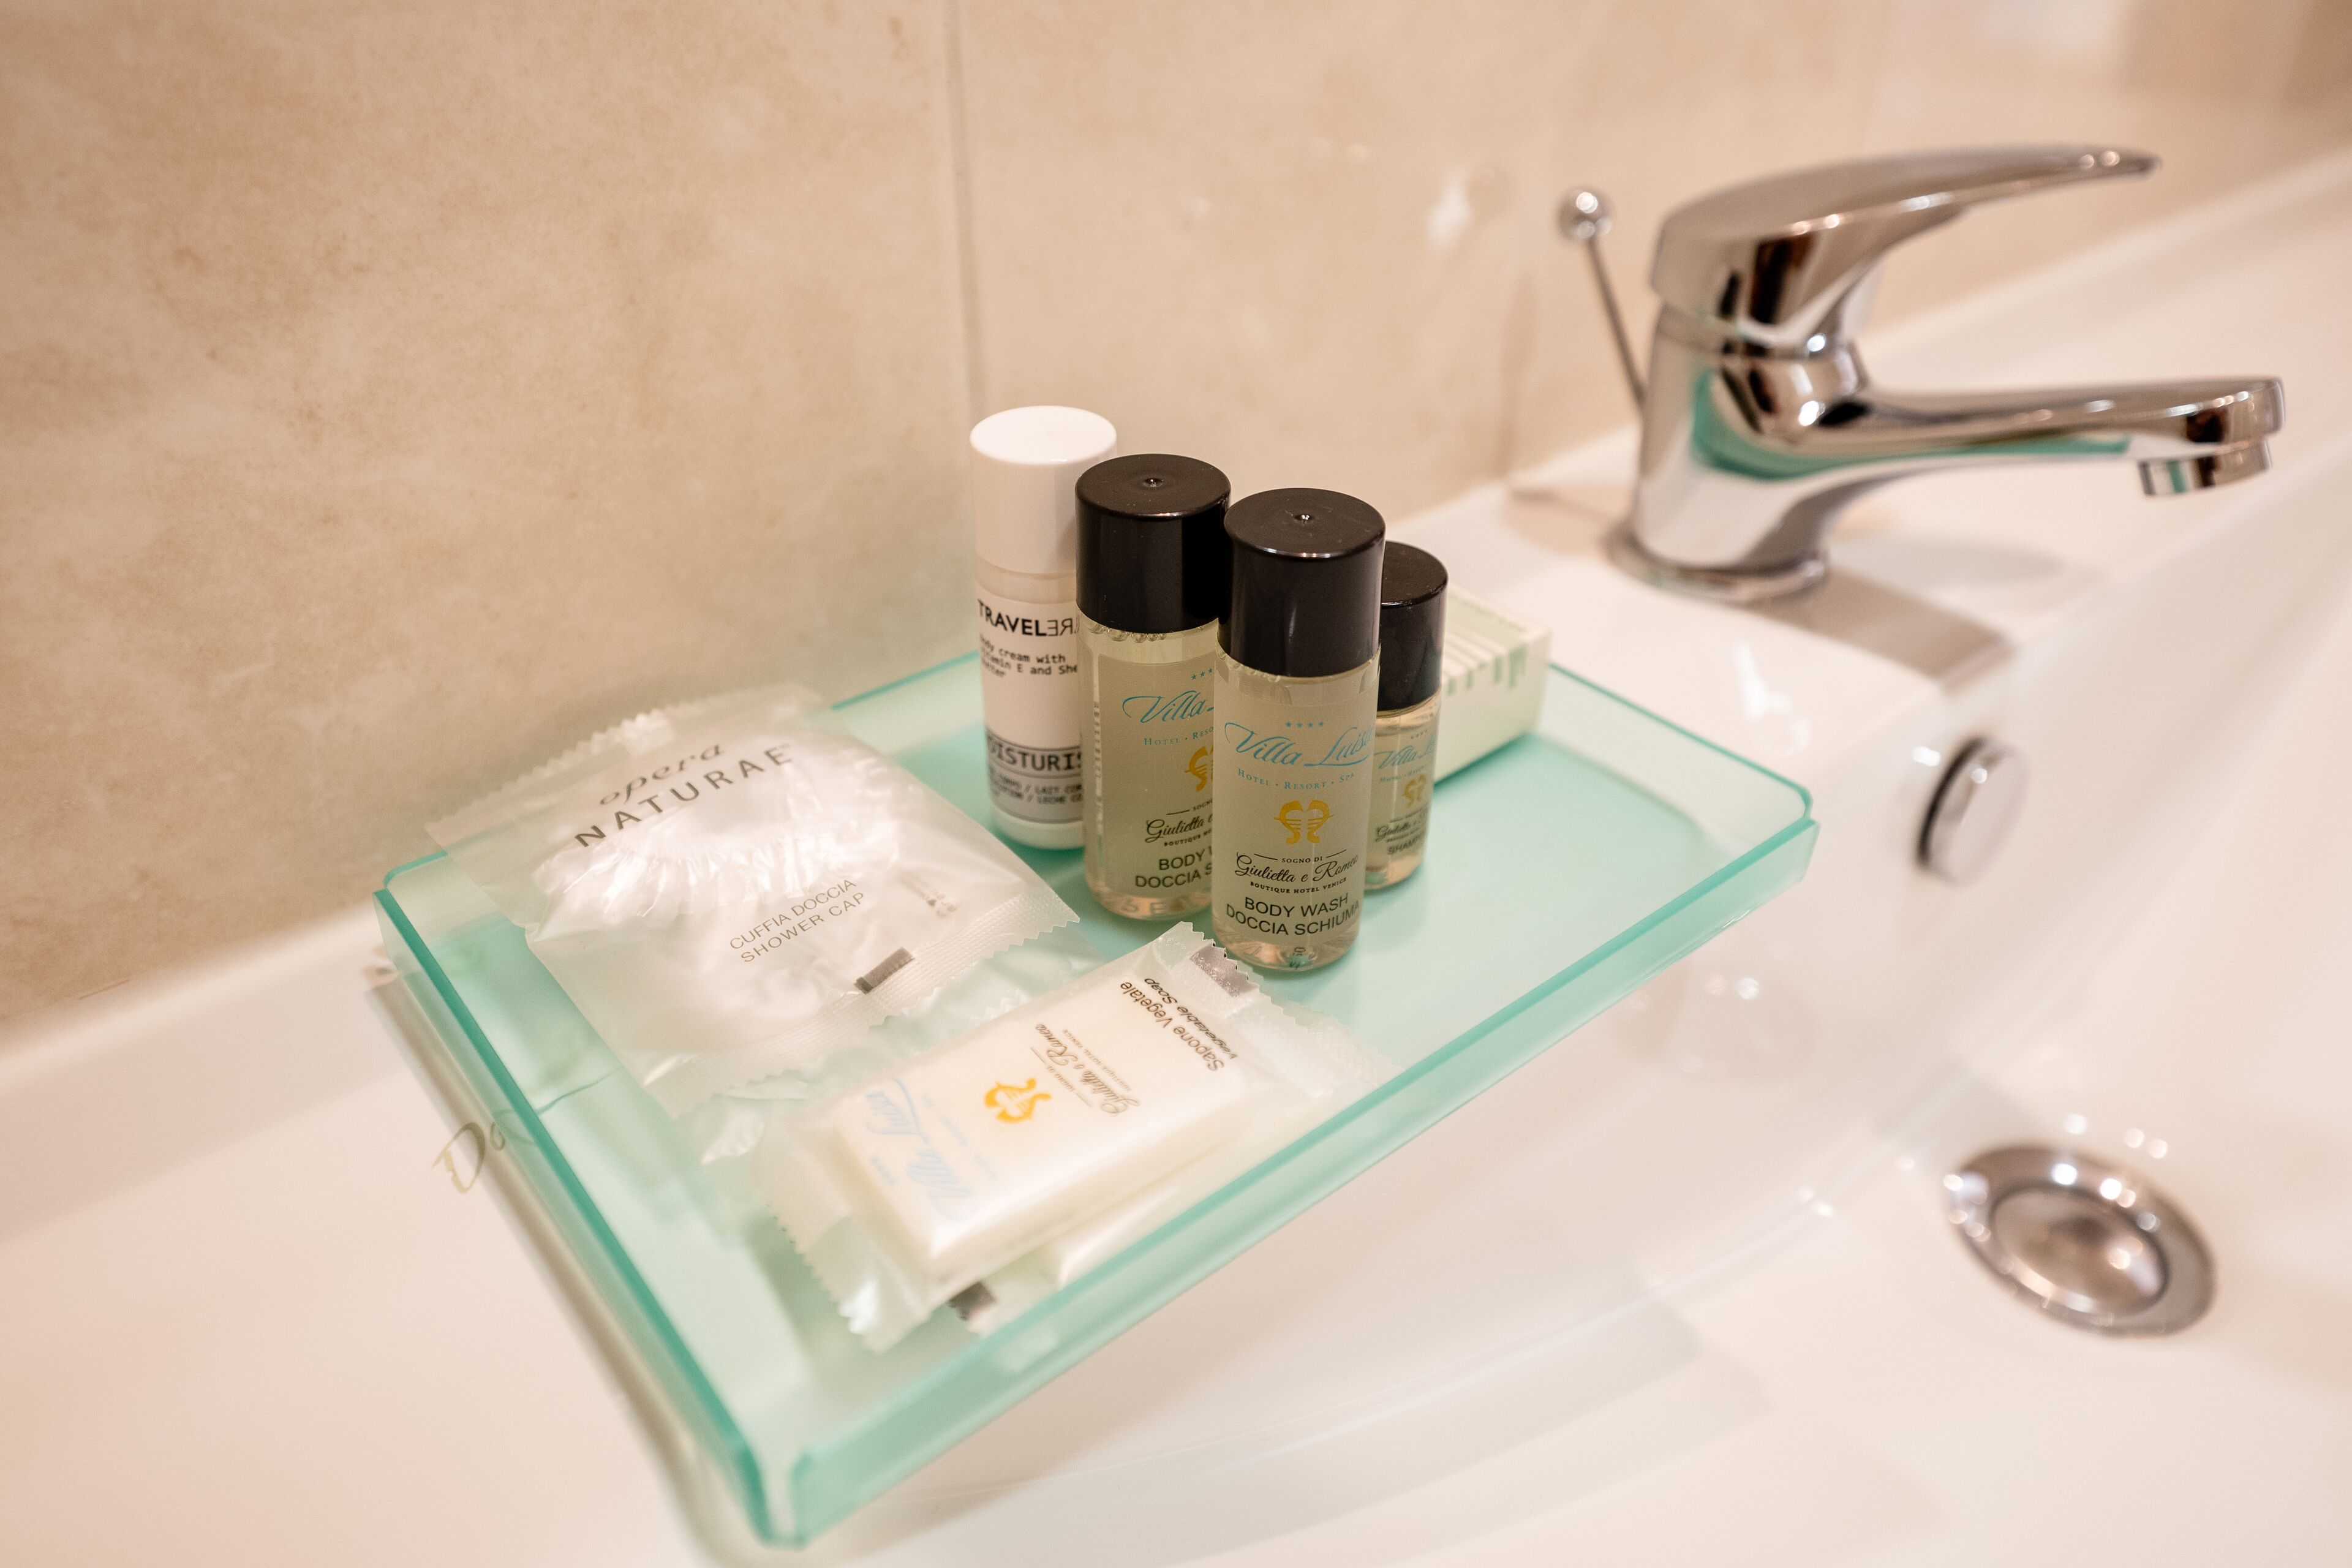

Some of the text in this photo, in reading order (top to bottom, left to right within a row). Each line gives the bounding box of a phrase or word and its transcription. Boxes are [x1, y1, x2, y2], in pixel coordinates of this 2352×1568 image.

[998, 648, 1030, 663] cream
[1035, 654, 1066, 664] with
[1017, 663, 1023, 673] E
[1030, 665, 1052, 675] and
[1122, 690, 1205, 723] Villa
[1225, 722, 1303, 766] Villa
[600, 743, 723, 805] opera
[575, 744, 792, 848] NATURAE
[1145, 815, 1205, 843] Giulietta
[1163, 834, 1201, 846] BOUTIQUE
[1159, 848, 1205, 870] BODY
[1234, 851, 1296, 883] Giulietta
[1301, 873, 1308, 882] e
[1313, 855, 1359, 881] Romeo
[1135, 869, 1202, 889] DOCCIA
[1250, 881, 1291, 894] BOUTIQUE
[1322, 876, 1347, 890] VENICE
[729, 913, 791, 949] CUFFIA
[791, 879, 857, 917] DOCCIA
[1226, 903, 1289, 935] DOCCIA
[1294, 900, 1359, 935] SCHIUMA
[1245, 892, 1349, 918] BODY WASH
[741, 914, 824, 963] SHOWER
[828, 892, 865, 917] CAP
[1120, 981, 1224, 1072] Sapone Vegetale
[1144, 978, 1238, 1060] Vegetable Soap
[1035, 1023, 1079, 1066] Romeo
[1080, 1071, 1140, 1117] Giulietta
